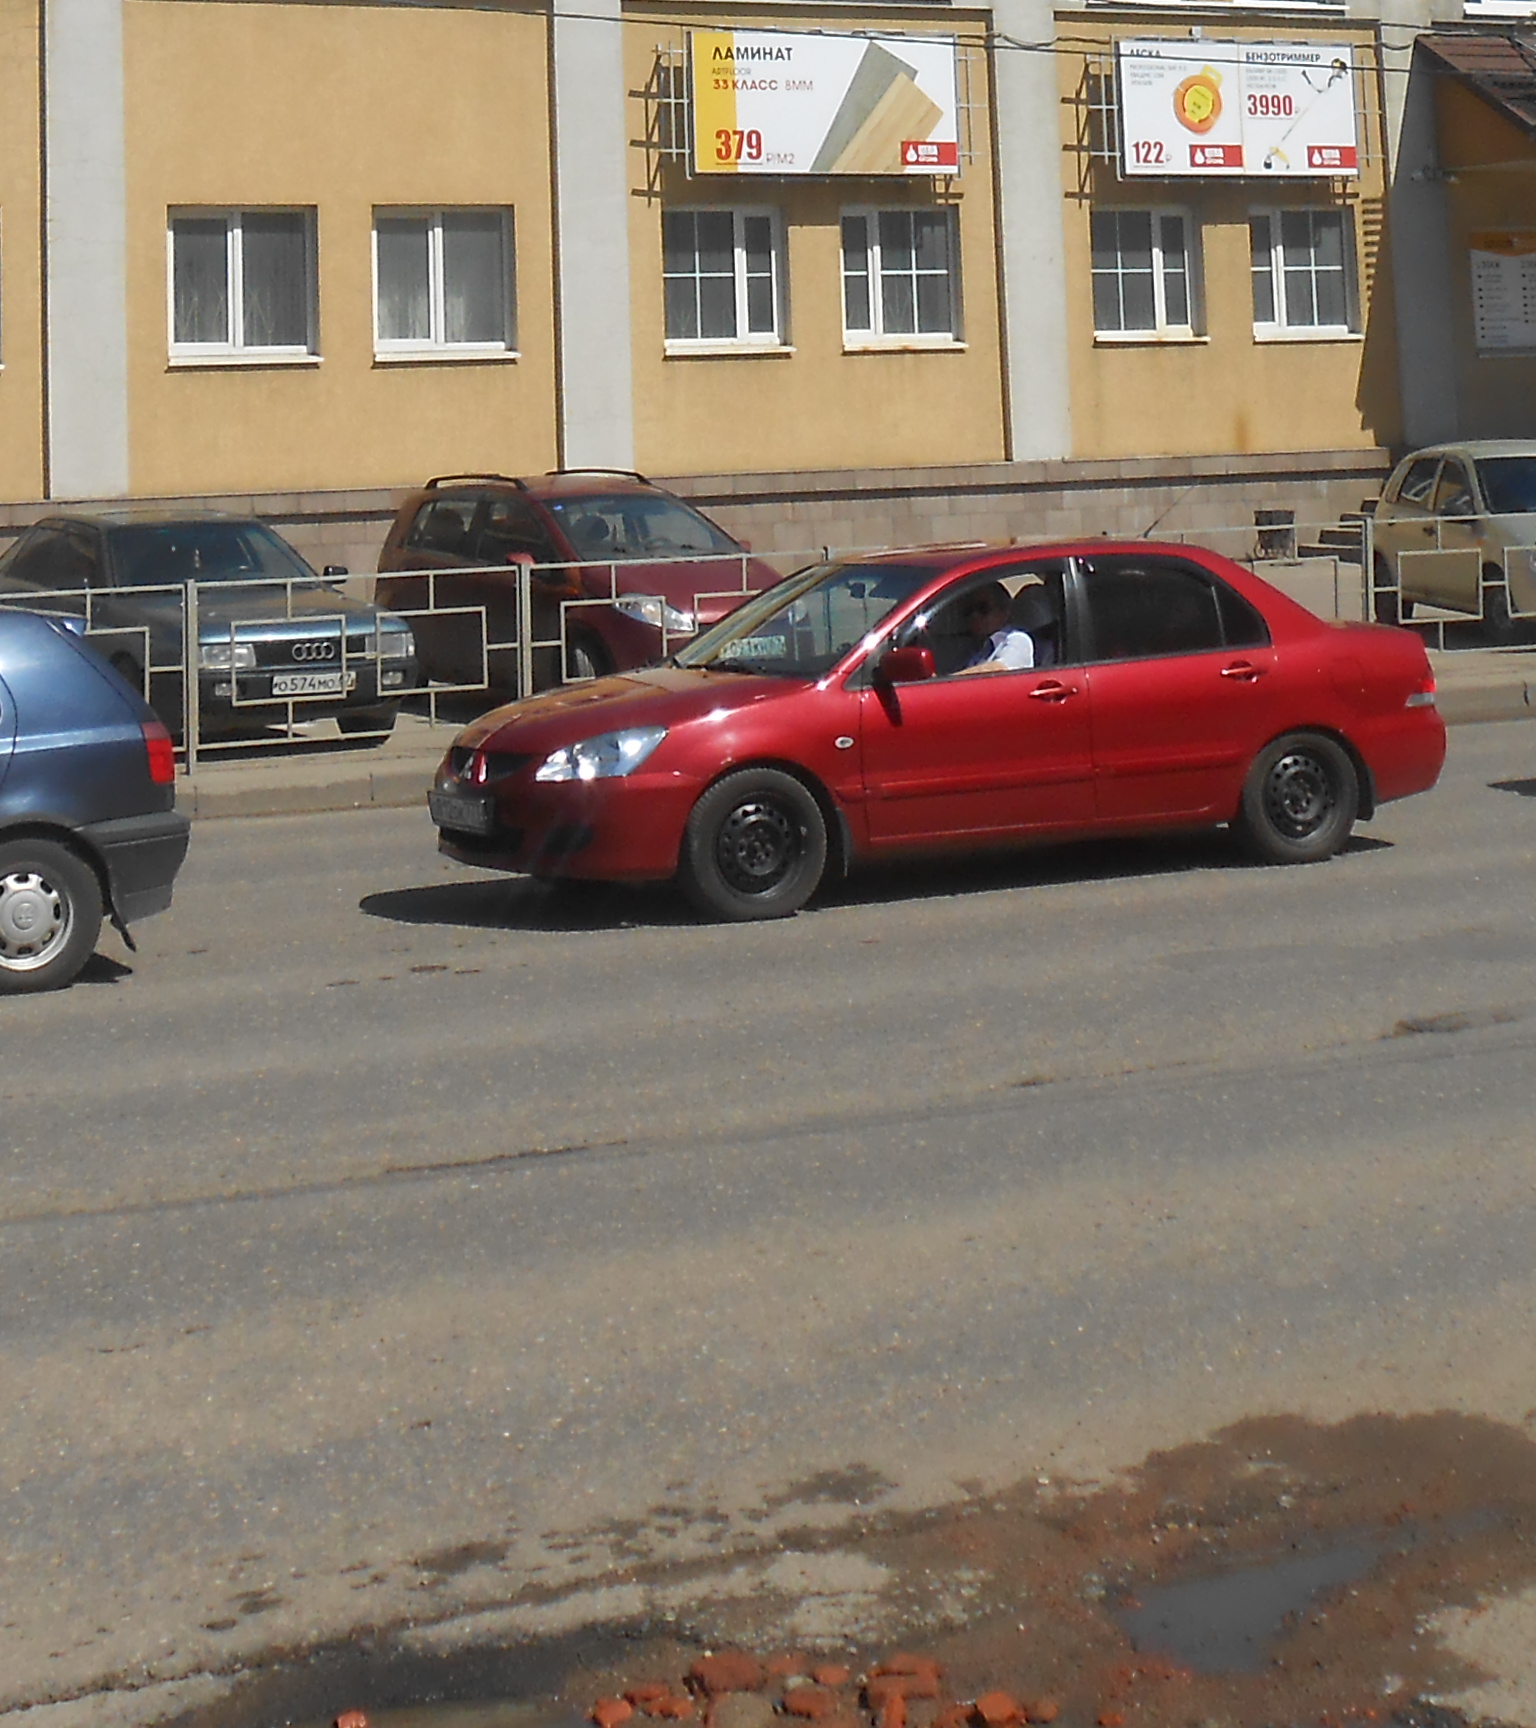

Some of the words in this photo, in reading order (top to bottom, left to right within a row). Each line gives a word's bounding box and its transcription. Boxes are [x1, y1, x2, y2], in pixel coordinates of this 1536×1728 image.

[712, 47, 794, 62] ЛАМИНАТ
[1245, 52, 1322, 63] БЕНЗОТРИММЕР
[713, 79, 729, 91] 33
[731, 79, 779, 92] КЛАСС
[1247, 93, 1294, 116] 3990
[715, 129, 763, 162] 379
[1132, 140, 1166, 164] 122
